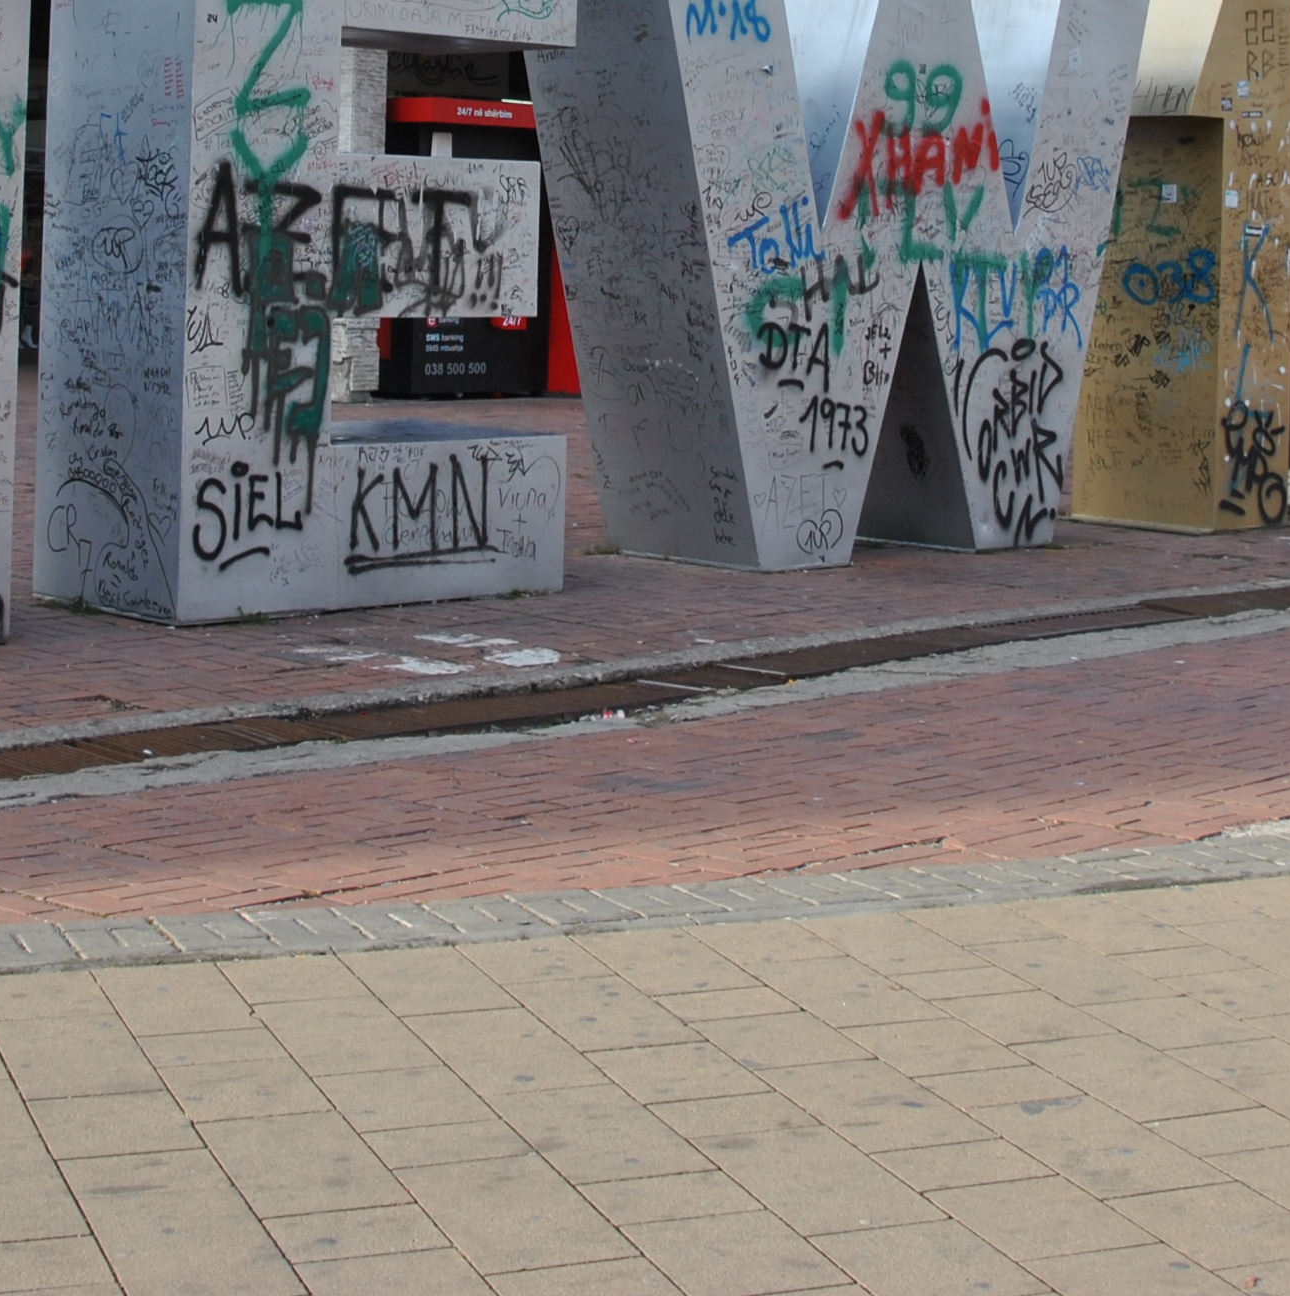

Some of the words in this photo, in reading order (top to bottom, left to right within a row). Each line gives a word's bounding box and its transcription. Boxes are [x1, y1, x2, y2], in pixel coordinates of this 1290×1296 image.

[456, 106, 472, 117] 24/7
[884, 59, 964, 135] 99
[1122, 248, 1215, 306] 038
[425, 363, 444, 376] 038
[447, 363, 465, 375] 500
[468, 362, 487, 375] 500
[799, 395, 870, 457] 1973
[349, 454, 489, 553] KMN
